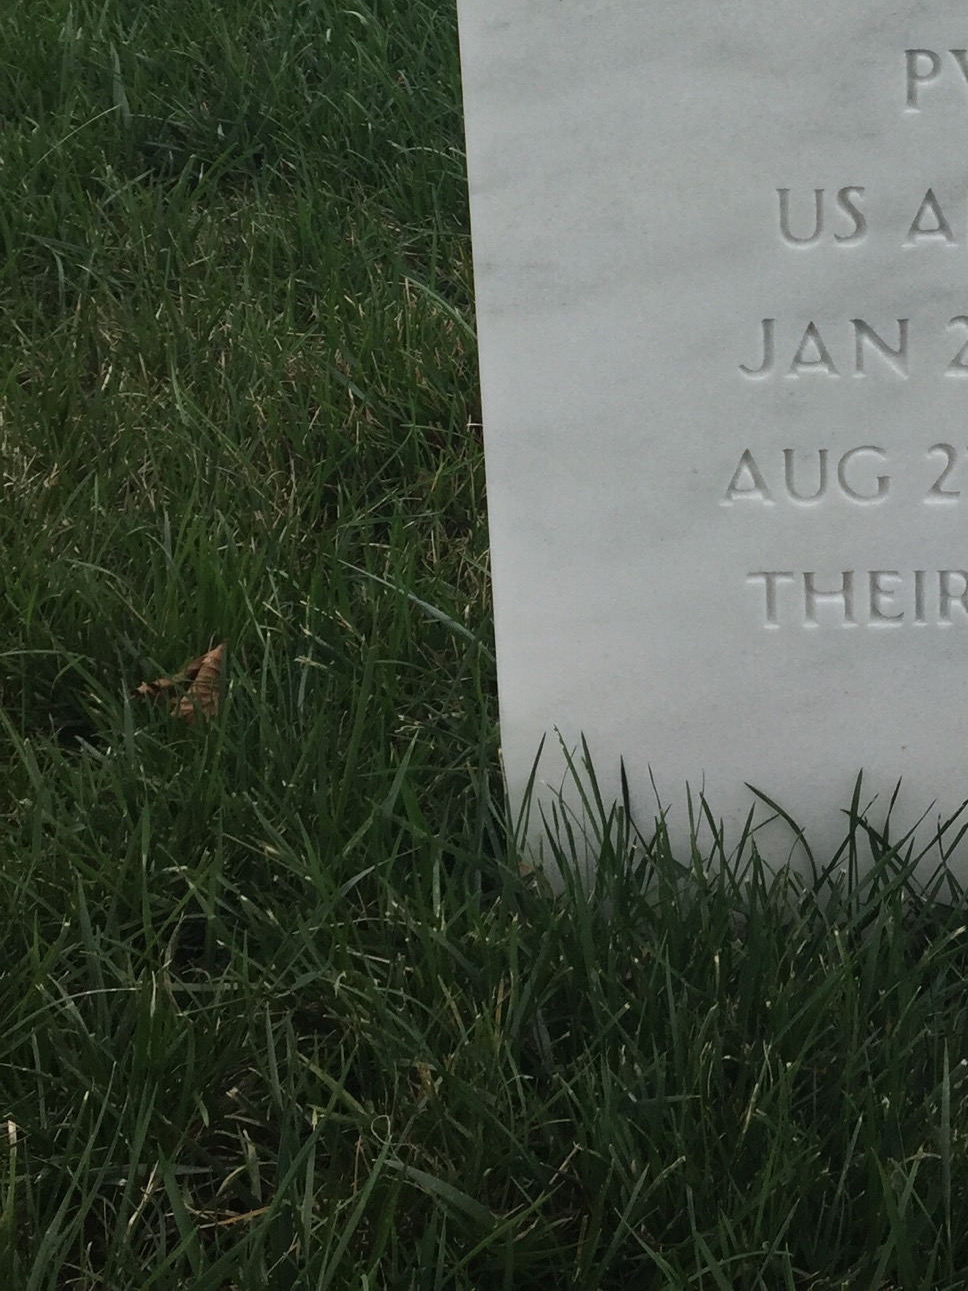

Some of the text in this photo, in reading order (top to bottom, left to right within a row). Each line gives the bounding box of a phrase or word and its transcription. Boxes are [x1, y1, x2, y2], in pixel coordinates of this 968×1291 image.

[775, 186, 870, 250] US
[737, 317, 910, 380] JAN
[719, 444, 893, 507] AUG
